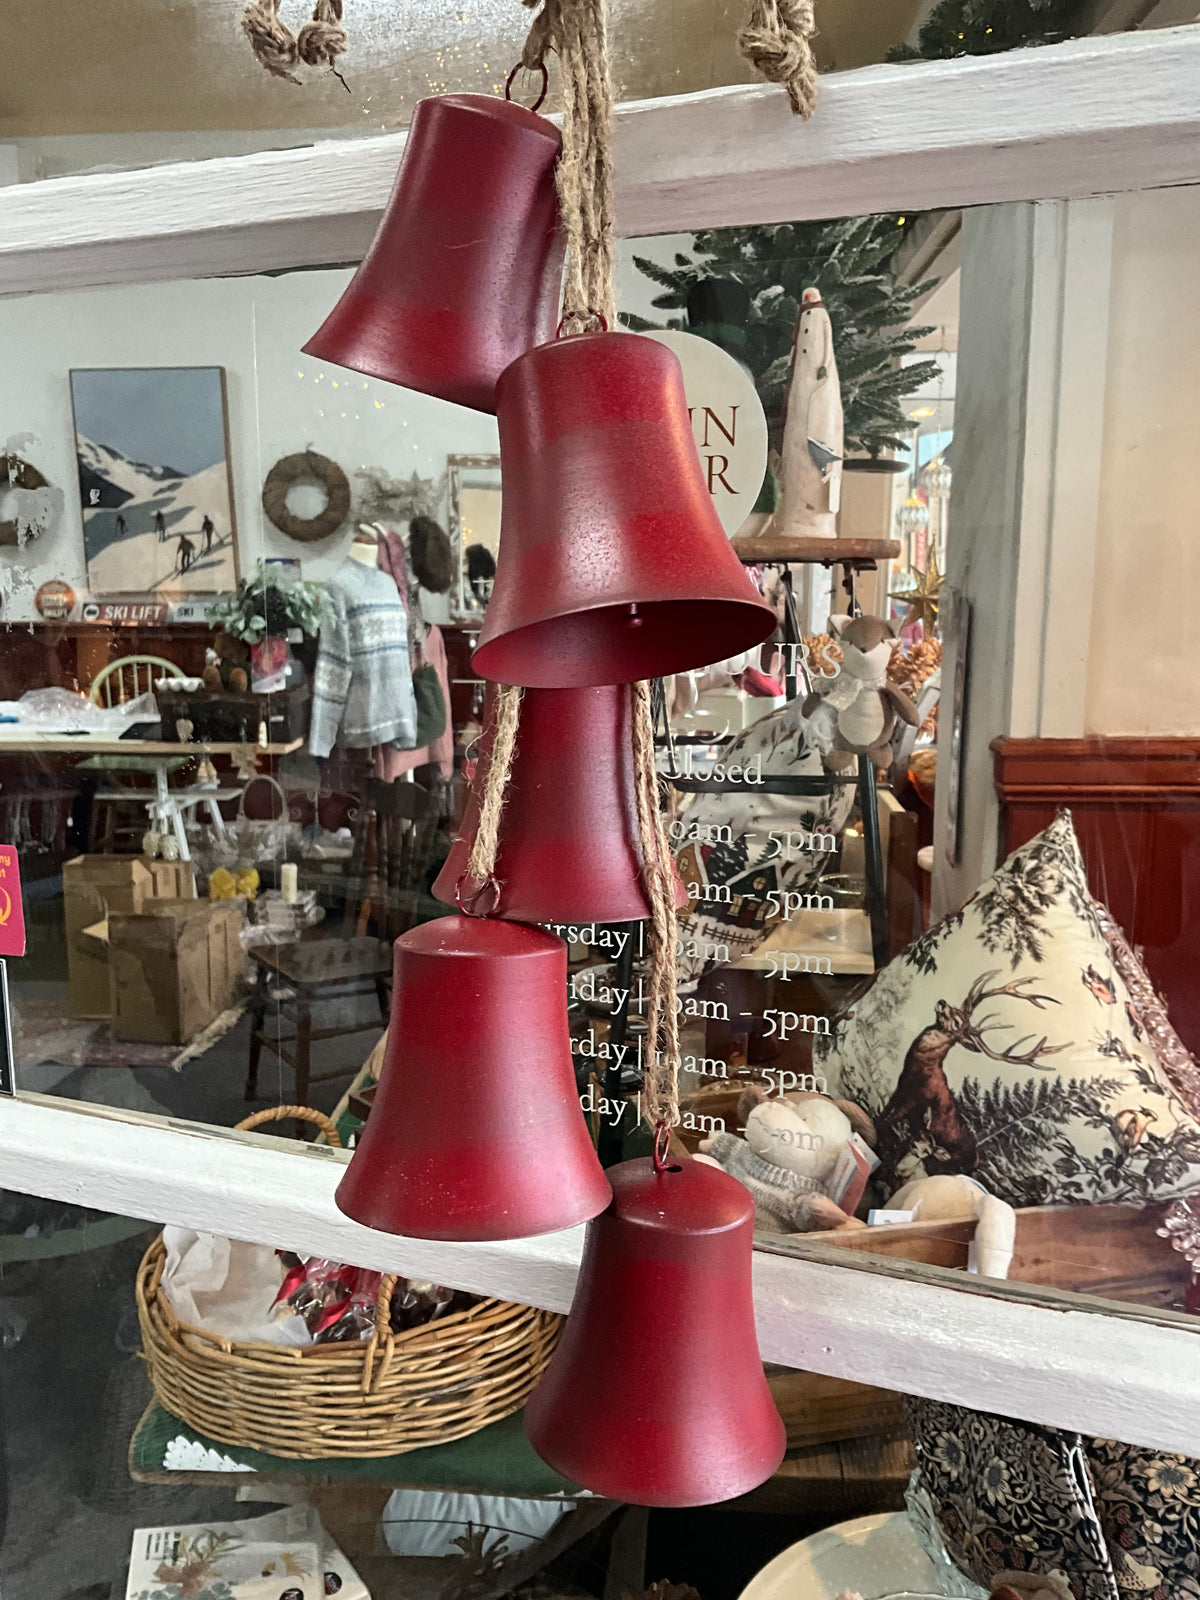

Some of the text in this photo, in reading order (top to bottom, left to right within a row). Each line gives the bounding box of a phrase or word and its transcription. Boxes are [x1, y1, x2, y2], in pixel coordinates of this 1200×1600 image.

[104, 604, 163, 619] SKI LIFT
[726, 642, 842, 680] OURS
[656, 748, 766, 785] Closed
[767, 830, 839, 860] 5pm
[765, 890, 835, 922] 5pm
[763, 949, 835, 982] 5pm
[566, 972, 630, 1015] iday
[762, 1008, 833, 1041] 5pm
[569, 1028, 629, 1071] rday
[761, 1067, 831, 1100] 5pm
[579, 1083, 629, 1127] day
